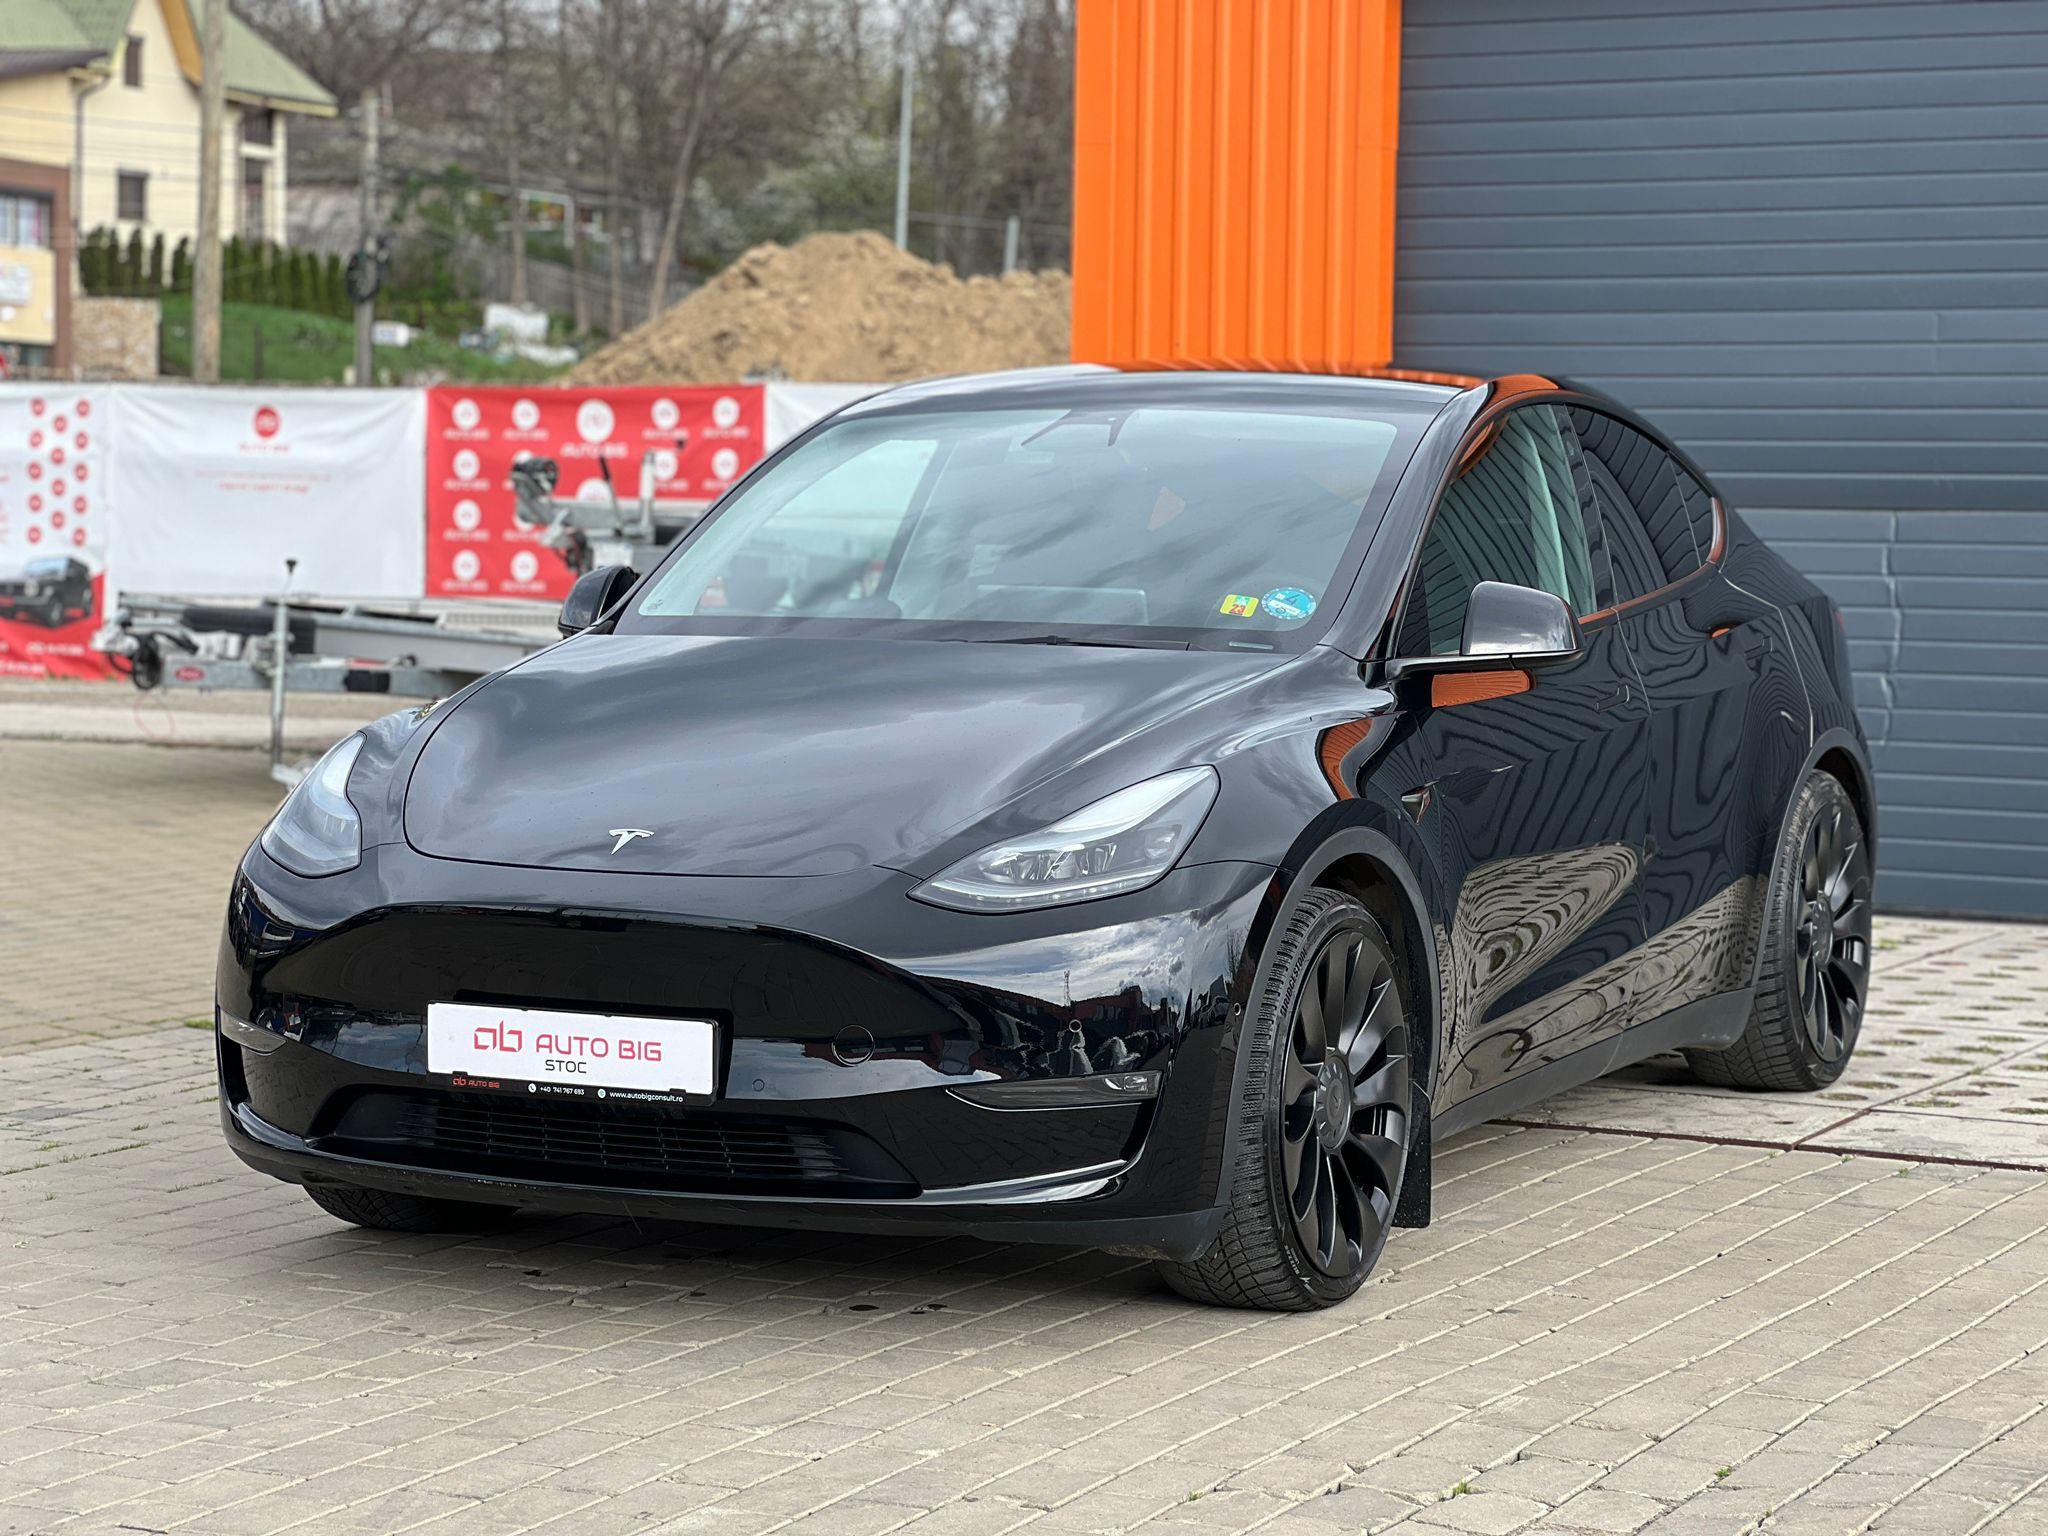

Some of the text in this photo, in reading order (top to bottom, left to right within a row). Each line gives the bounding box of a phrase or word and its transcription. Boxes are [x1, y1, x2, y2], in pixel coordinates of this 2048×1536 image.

[536, 1034, 609, 1058] AUTO
[618, 1039, 662, 1062] BIG
[545, 1059, 587, 1074] STOC
[488, 1081, 500, 1089] BIG
[609, 1091, 684, 1103] www.autobigconsult.ro
